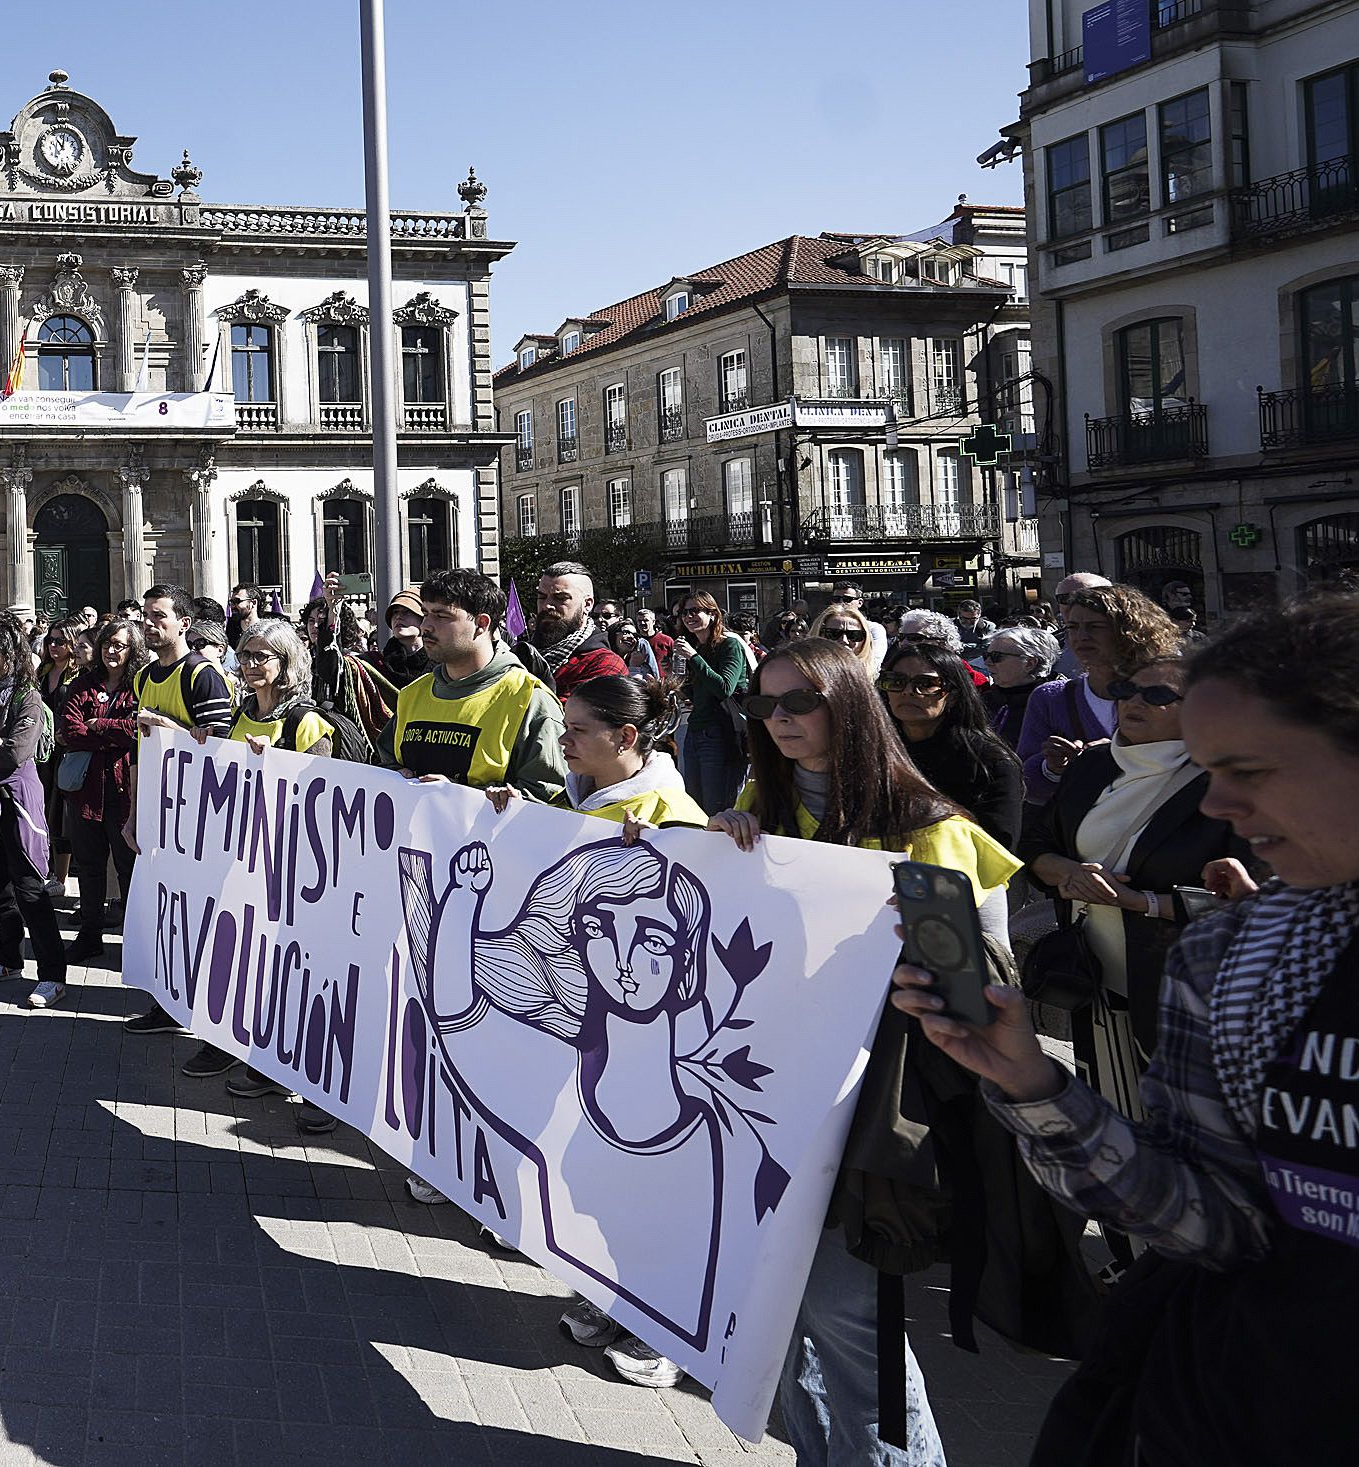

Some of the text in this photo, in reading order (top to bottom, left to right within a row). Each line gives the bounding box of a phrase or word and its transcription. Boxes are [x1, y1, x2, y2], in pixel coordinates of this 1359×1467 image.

[31, 203, 159, 222] CONSISTORIAL
[45, 412, 56, 420] na
[58, 412, 76, 420] casa
[159, 402, 168, 415] 8
[709, 408, 791, 433] CLINICA DENTAL
[639, 573, 648, 585] P
[677, 563, 742, 576] MICHELENA
[424, 729, 471, 748] ACTIVISTA
[352, 891, 365, 937] E
[1280, 1168, 1353, 1209] Tierra
[1300, 1205, 1343, 1233] son
